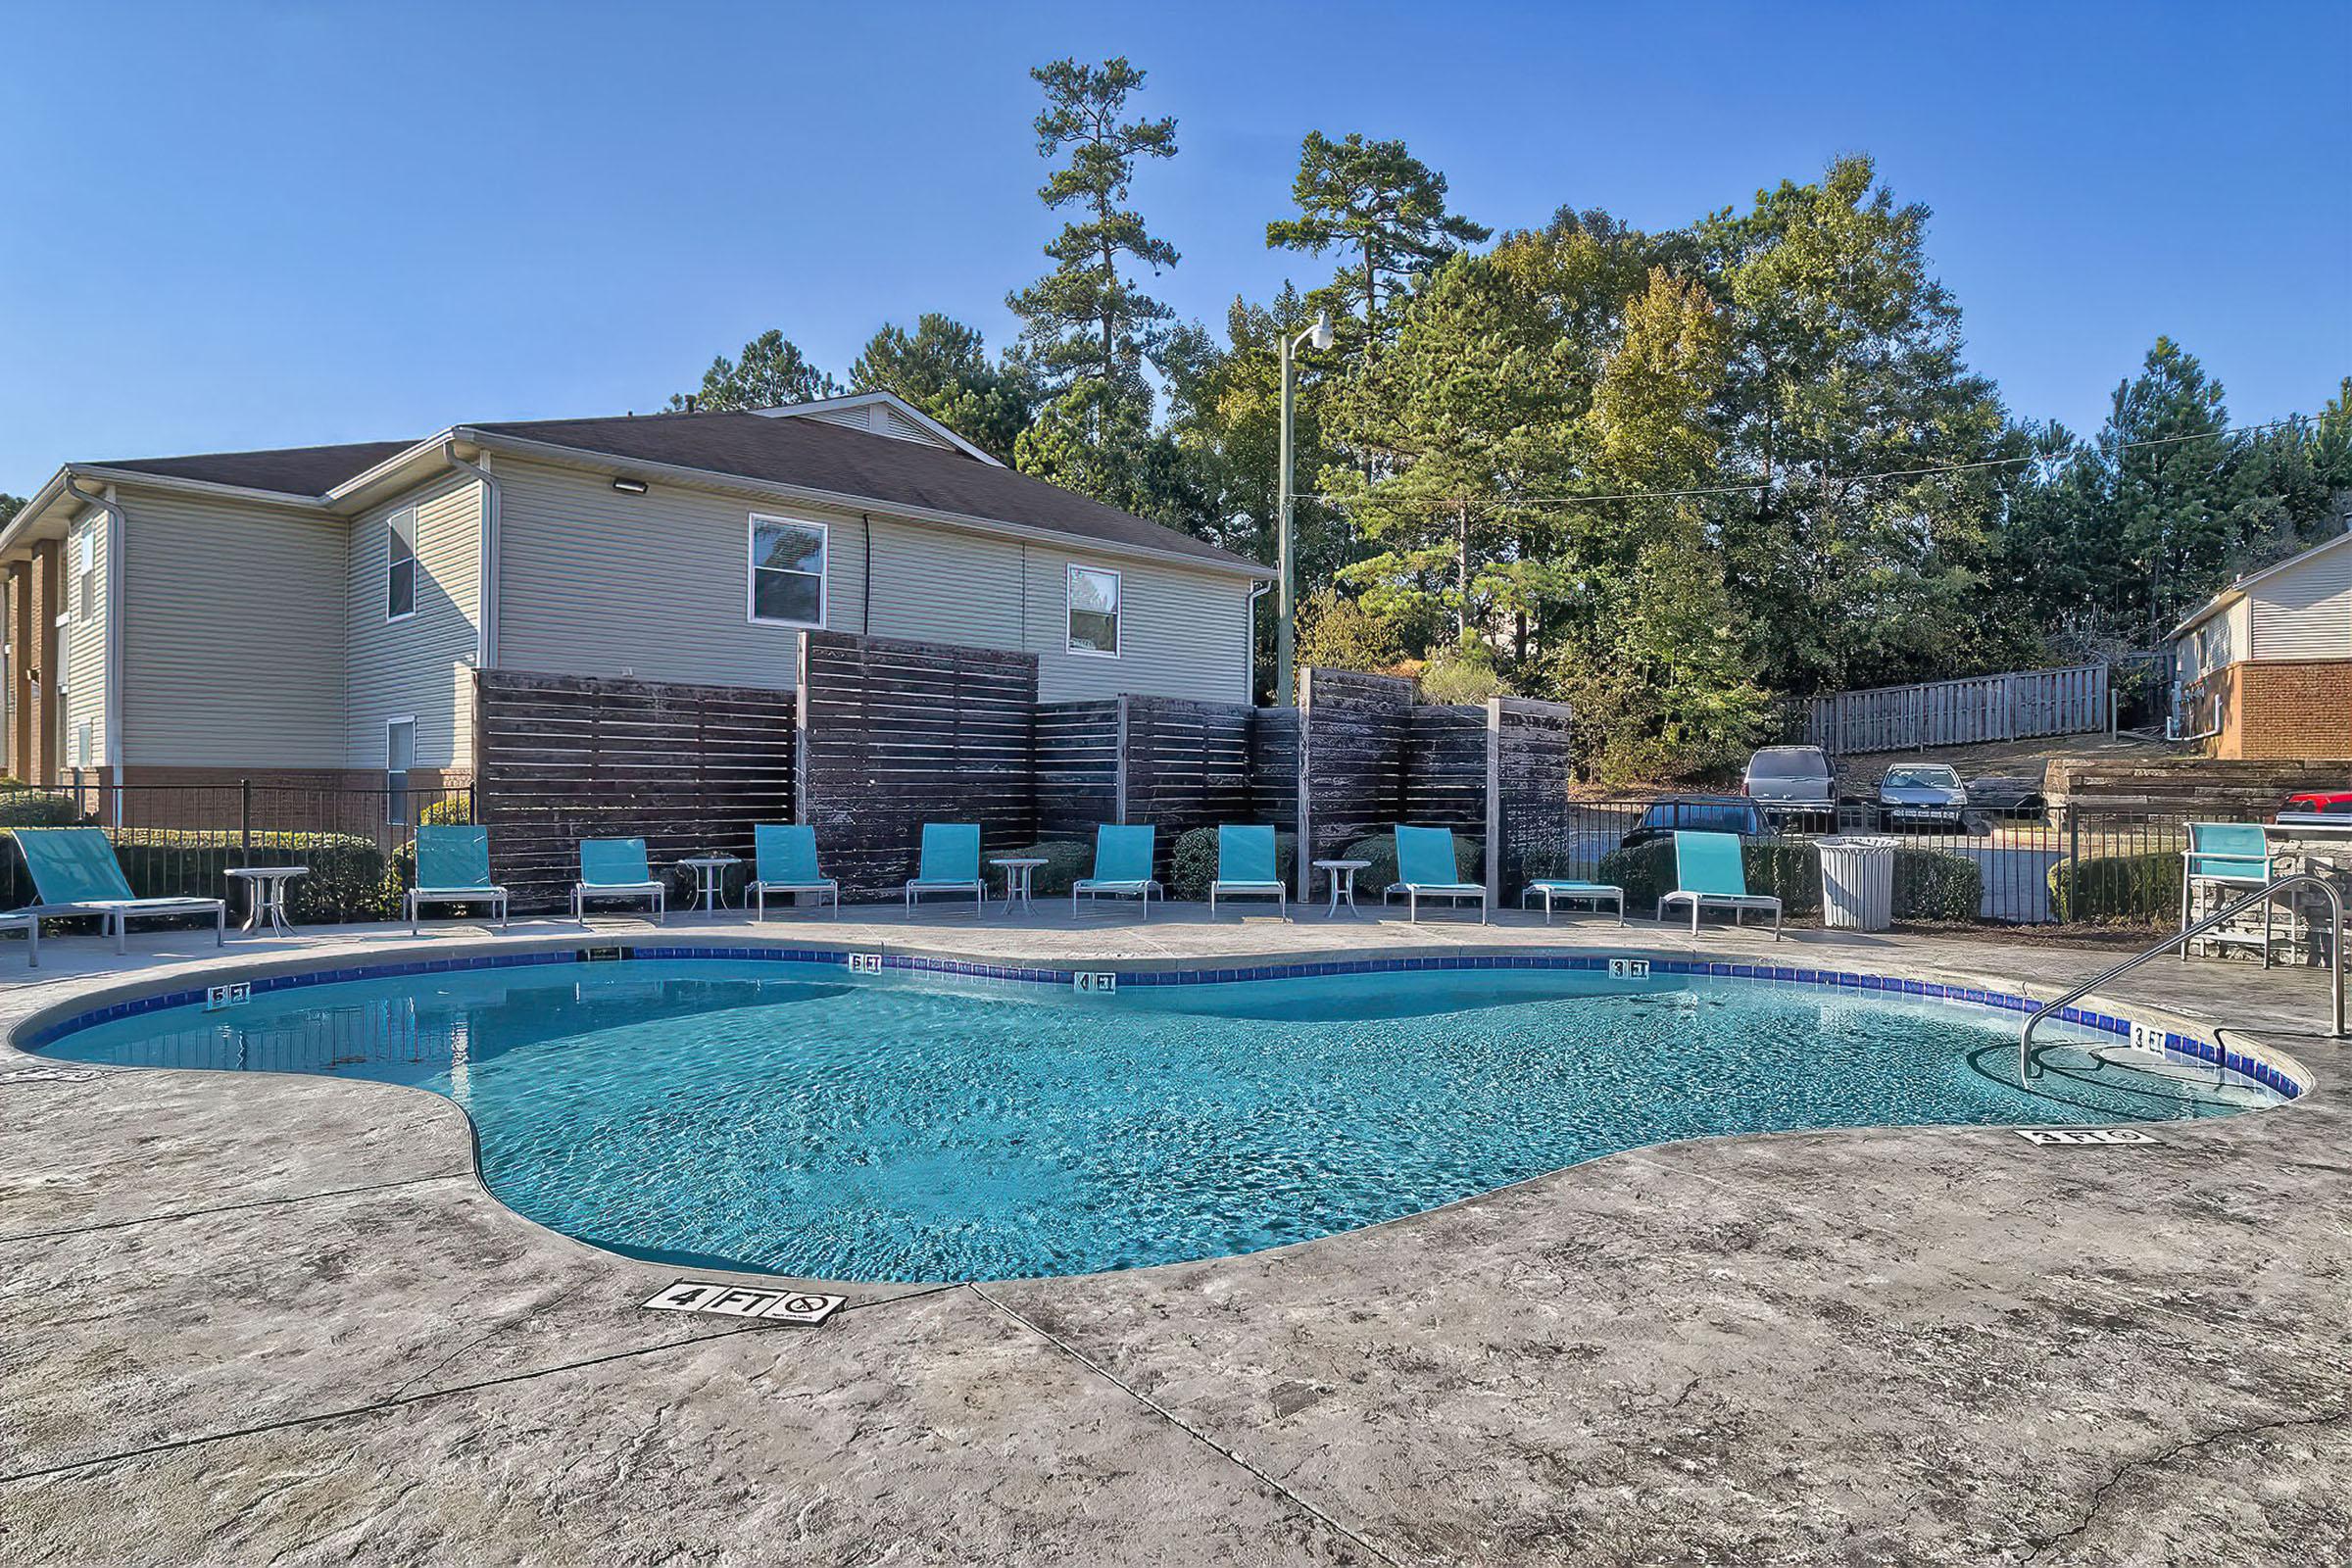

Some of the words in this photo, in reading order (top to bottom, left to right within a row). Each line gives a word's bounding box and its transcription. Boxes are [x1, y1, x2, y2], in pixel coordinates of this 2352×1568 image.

[1614, 960, 1623, 977] 3
[1631, 961, 1647, 978] FT
[1080, 973, 1089, 990] 4
[1097, 974, 1112, 992] FT
[2135, 1027, 2143, 1049] 3
[2149, 1030, 2163, 1055] FT
[2033, 1132, 2061, 1142] 3
[2063, 1132, 2106, 1143] FT
[667, 1288, 709, 1306] 4
[710, 1291, 778, 1312] FT
